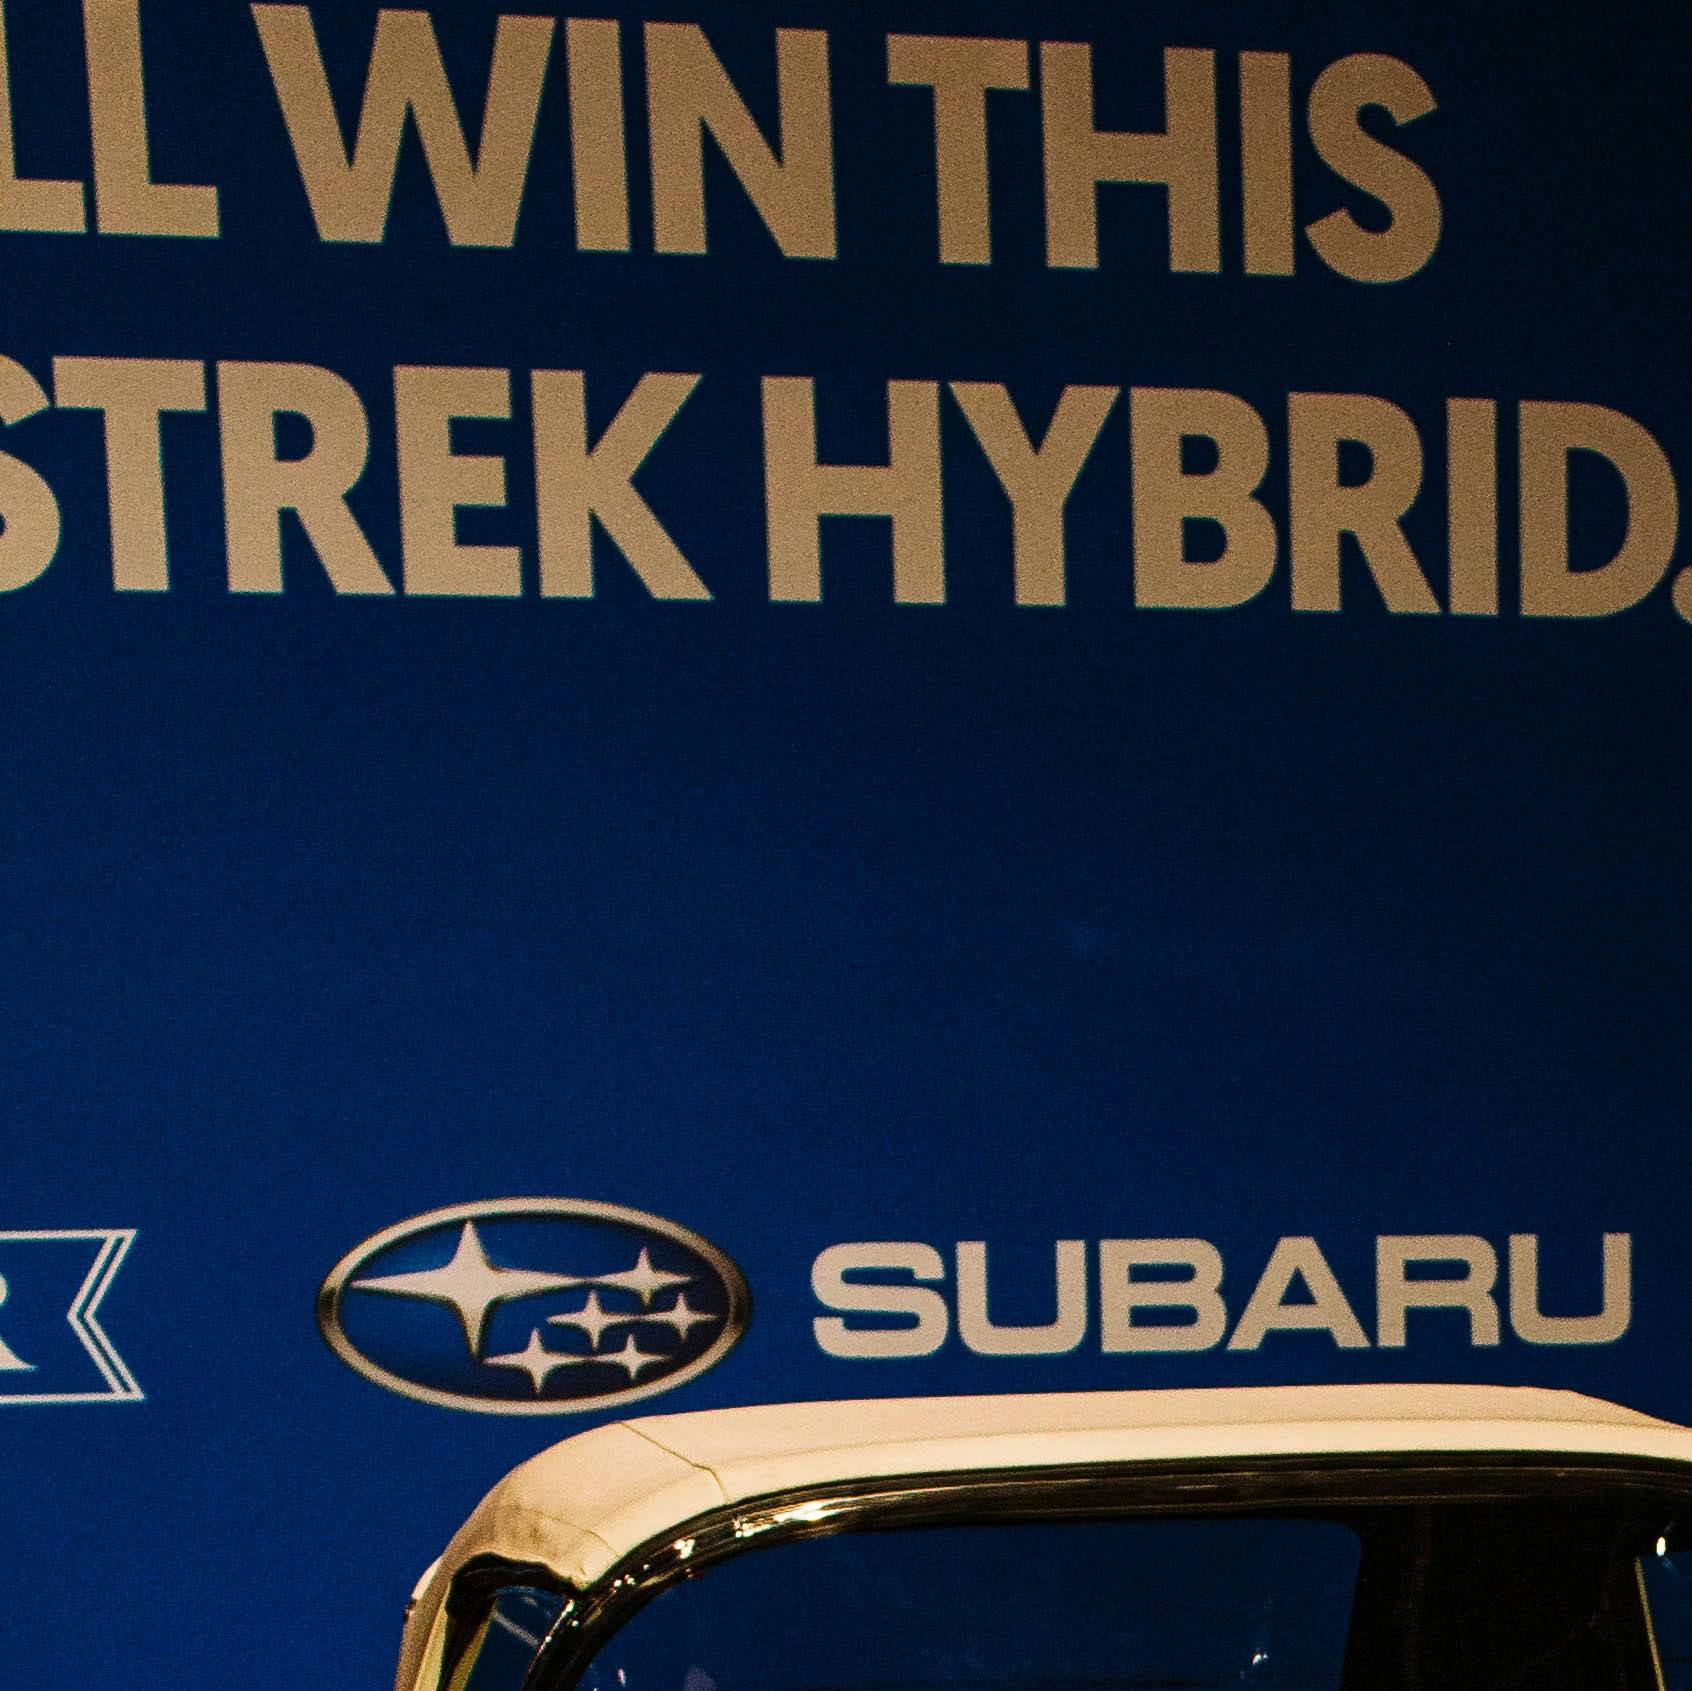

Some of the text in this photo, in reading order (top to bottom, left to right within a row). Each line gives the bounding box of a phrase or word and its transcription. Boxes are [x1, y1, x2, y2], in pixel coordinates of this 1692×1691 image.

[249, 3, 838, 260] WIN
[886, 34, 1442, 284] THIS
[810, 1232, 1633, 1358] SUBARU
